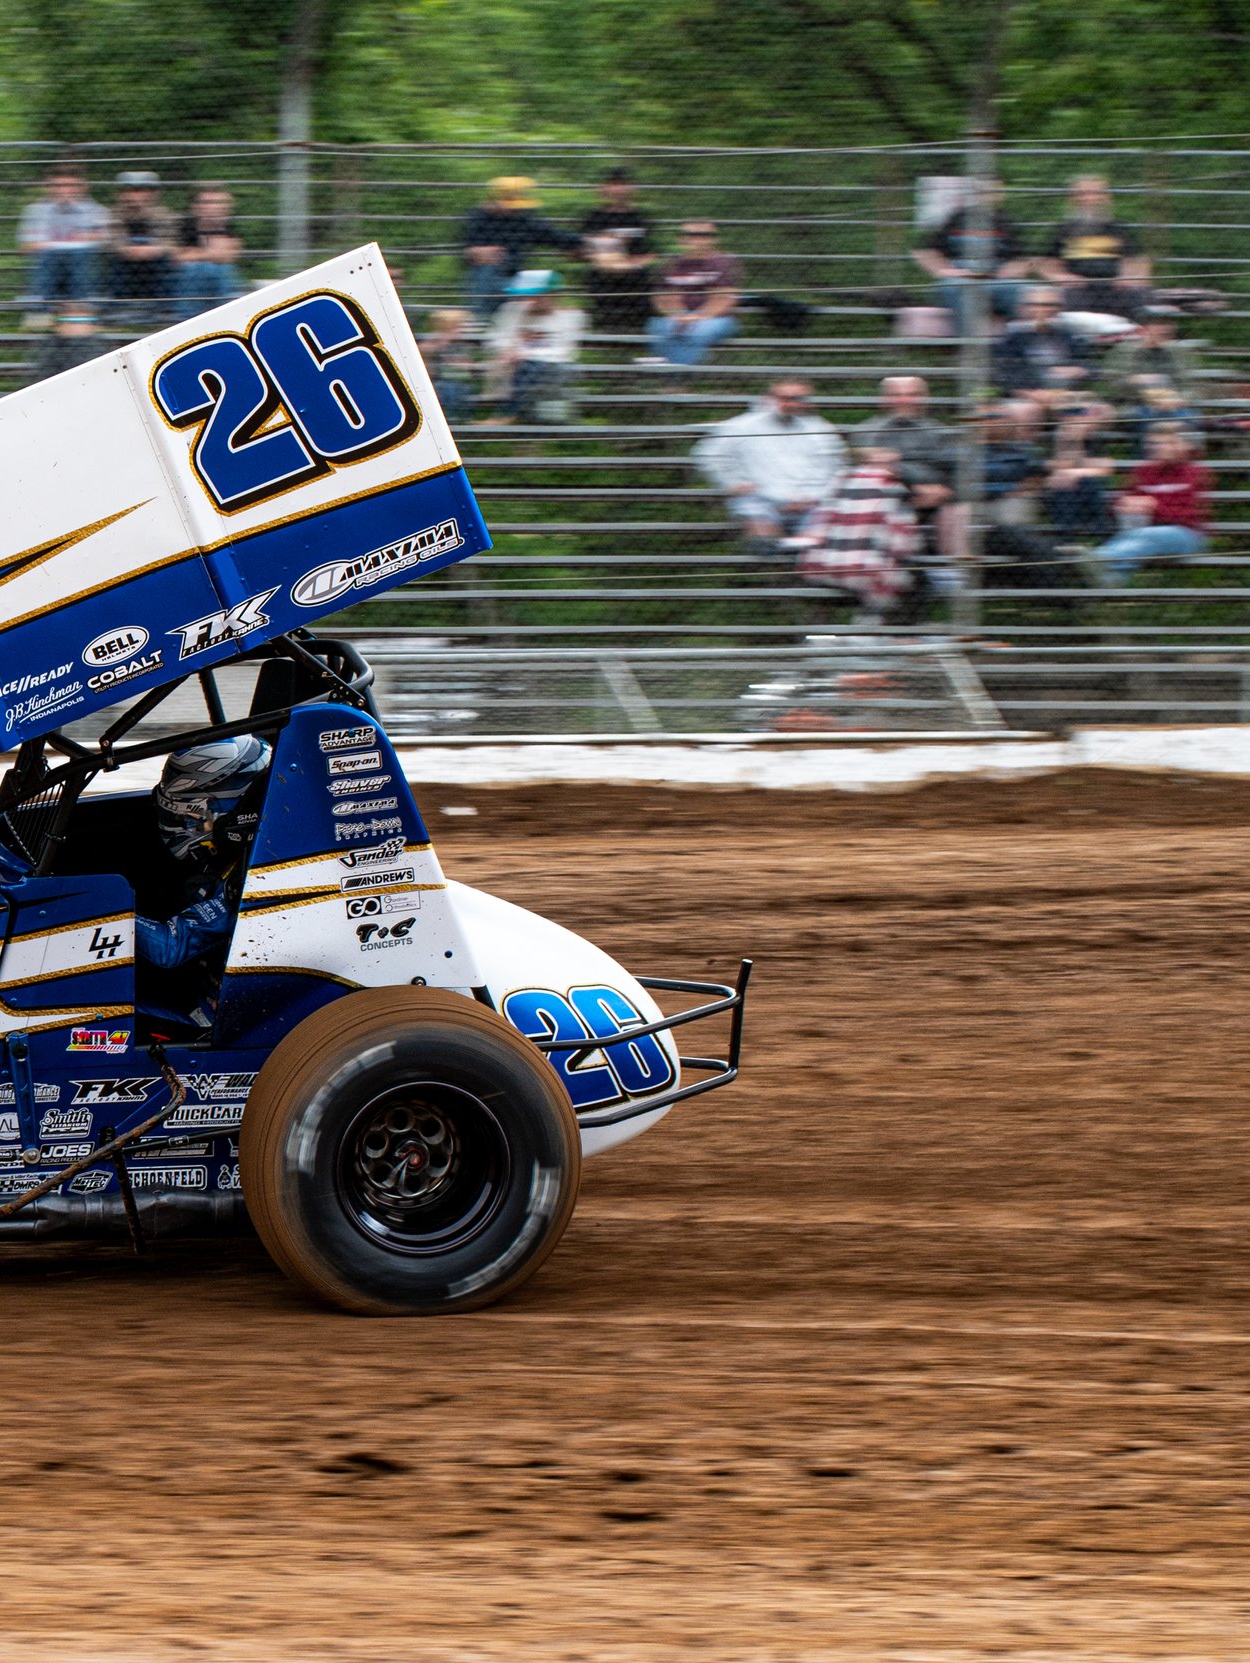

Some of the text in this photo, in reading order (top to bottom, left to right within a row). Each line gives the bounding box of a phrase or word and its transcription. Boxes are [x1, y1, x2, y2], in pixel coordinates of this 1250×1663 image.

[152, 293, 410, 508] 26
[355, 537, 459, 586] RACING OILS
[231, 618, 266, 638] KAHNE
[91, 633, 140, 661] BELL
[87, 649, 162, 689] COBALT
[30, 696, 85, 722] INDIANAPOLIS
[320, 727, 374, 742] SHARP
[321, 735, 375, 748] ADVANTAGE
[331, 757, 377, 770] Snap-on
[347, 896, 381, 918] GO
[360, 937, 413, 952] CONCEPTS
[501, 984, 677, 1114] 26
[41, 1107, 90, 1126] Smith
[169, 1106, 242, 1121] UICKCAR
[41, 1144, 91, 1158] JOES
[130, 1167, 204, 1188] CHOENFELD
